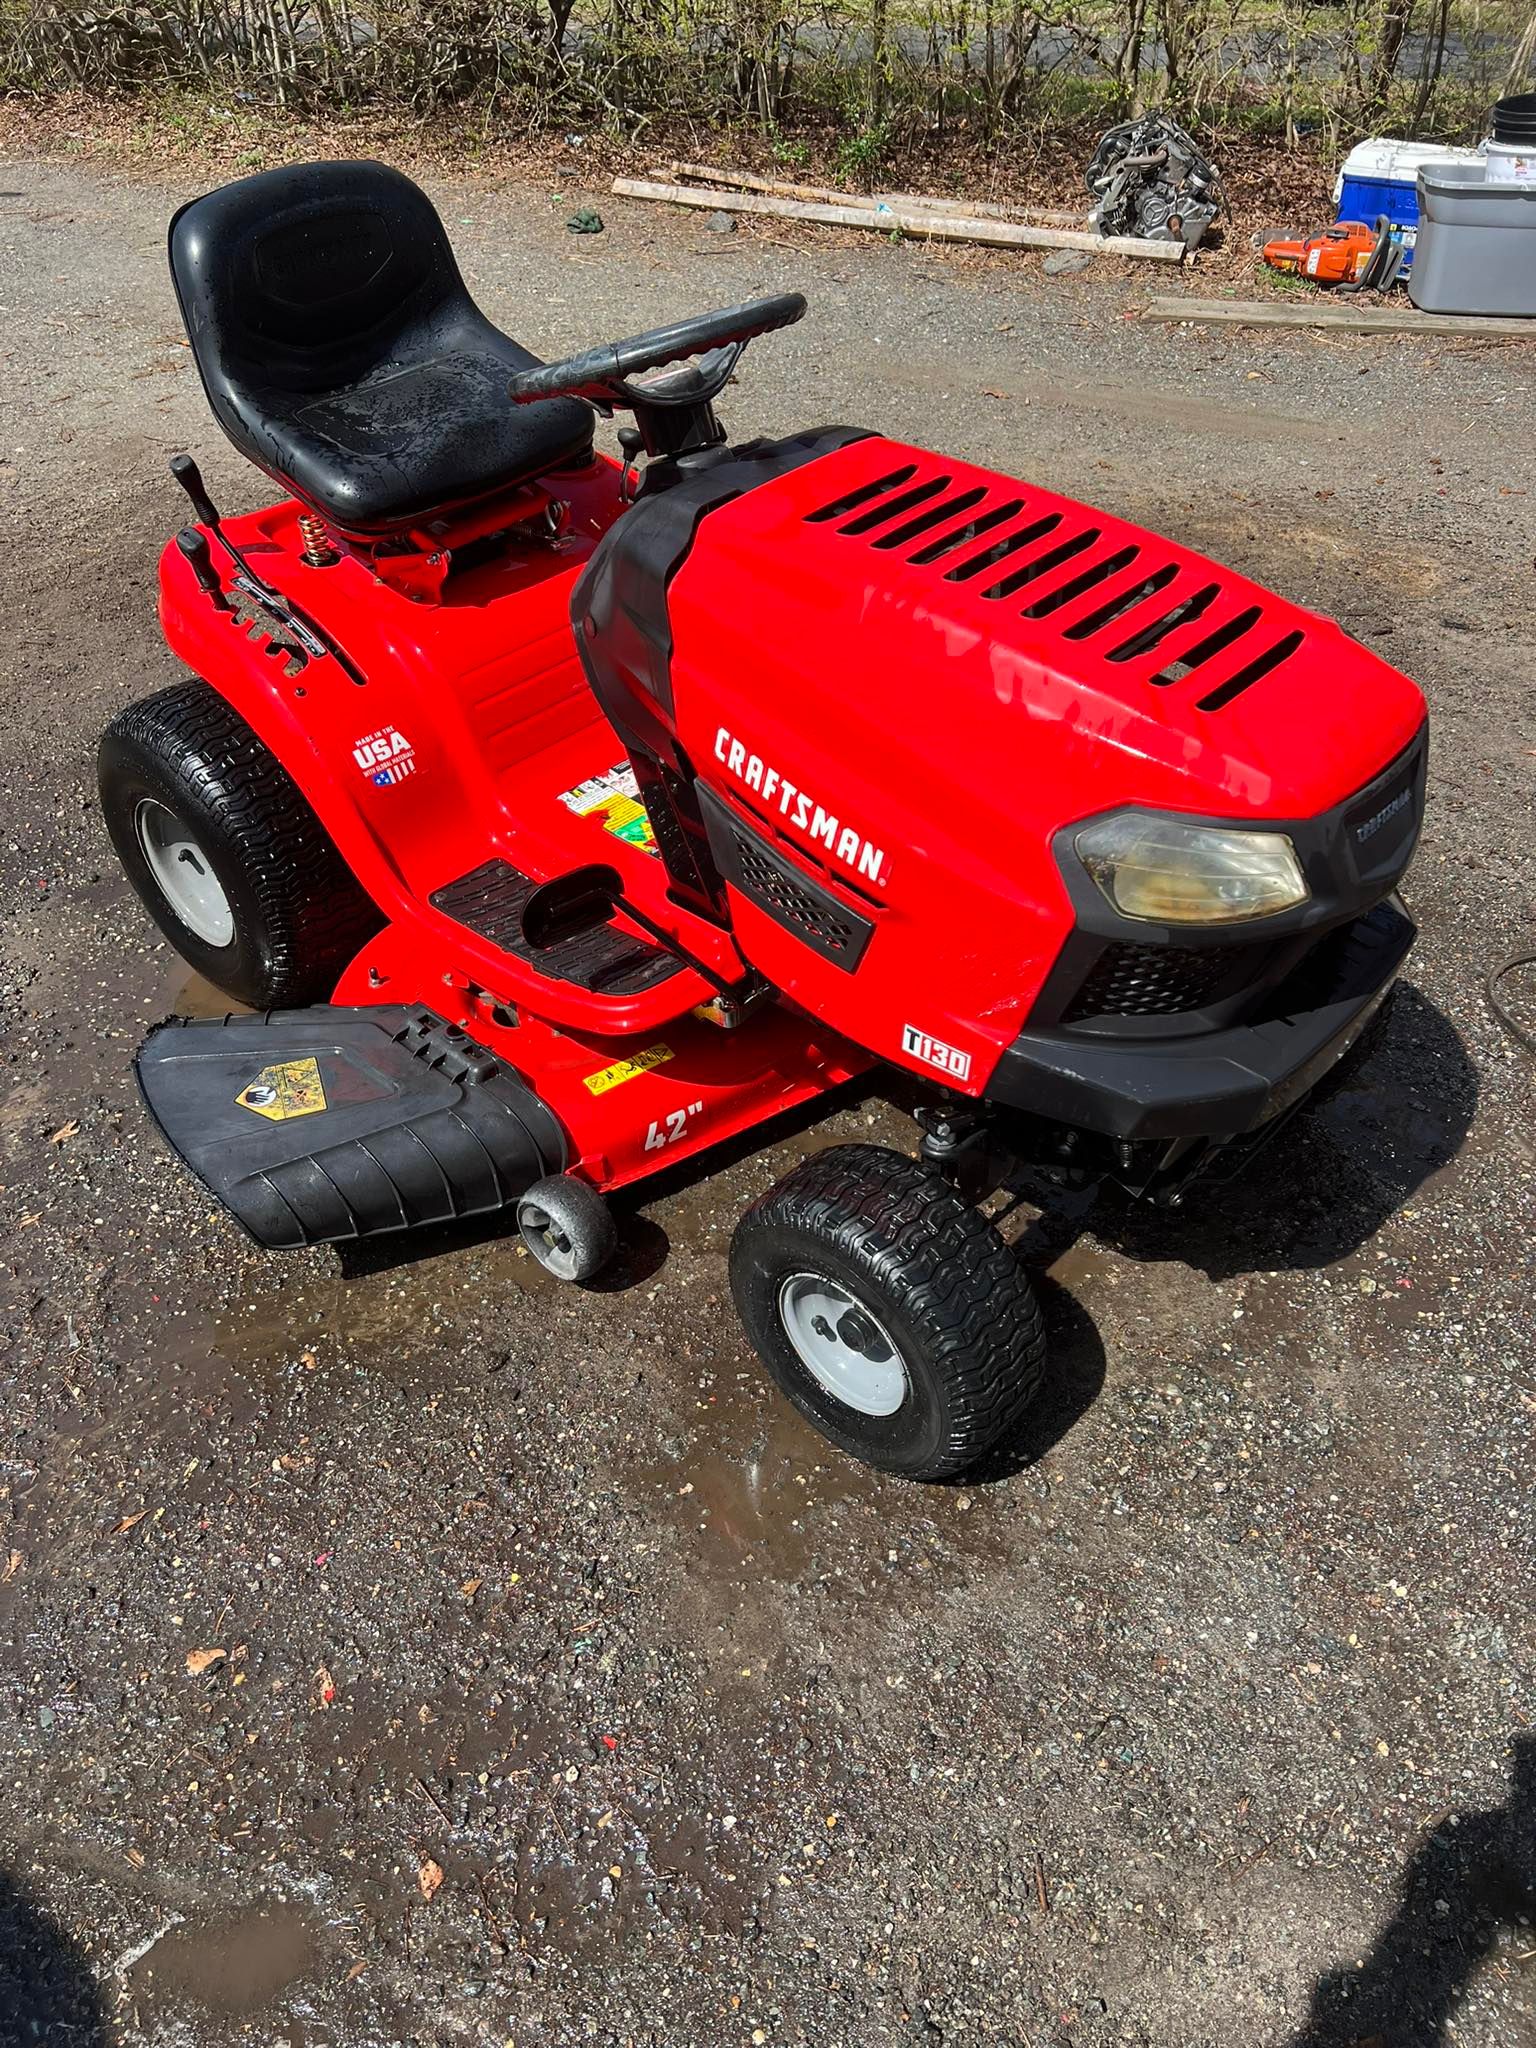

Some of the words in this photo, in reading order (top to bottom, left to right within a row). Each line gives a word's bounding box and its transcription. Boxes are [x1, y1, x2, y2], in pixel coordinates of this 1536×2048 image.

[352, 731, 412, 770] USA
[354, 734, 375, 747] MADE
[374, 731, 382, 739] IN
[382, 725, 395, 735] THE
[714, 727, 885, 883] CRAFTSMAN
[906, 1027, 967, 1076] T130
[644, 1100, 703, 1151] 42"
